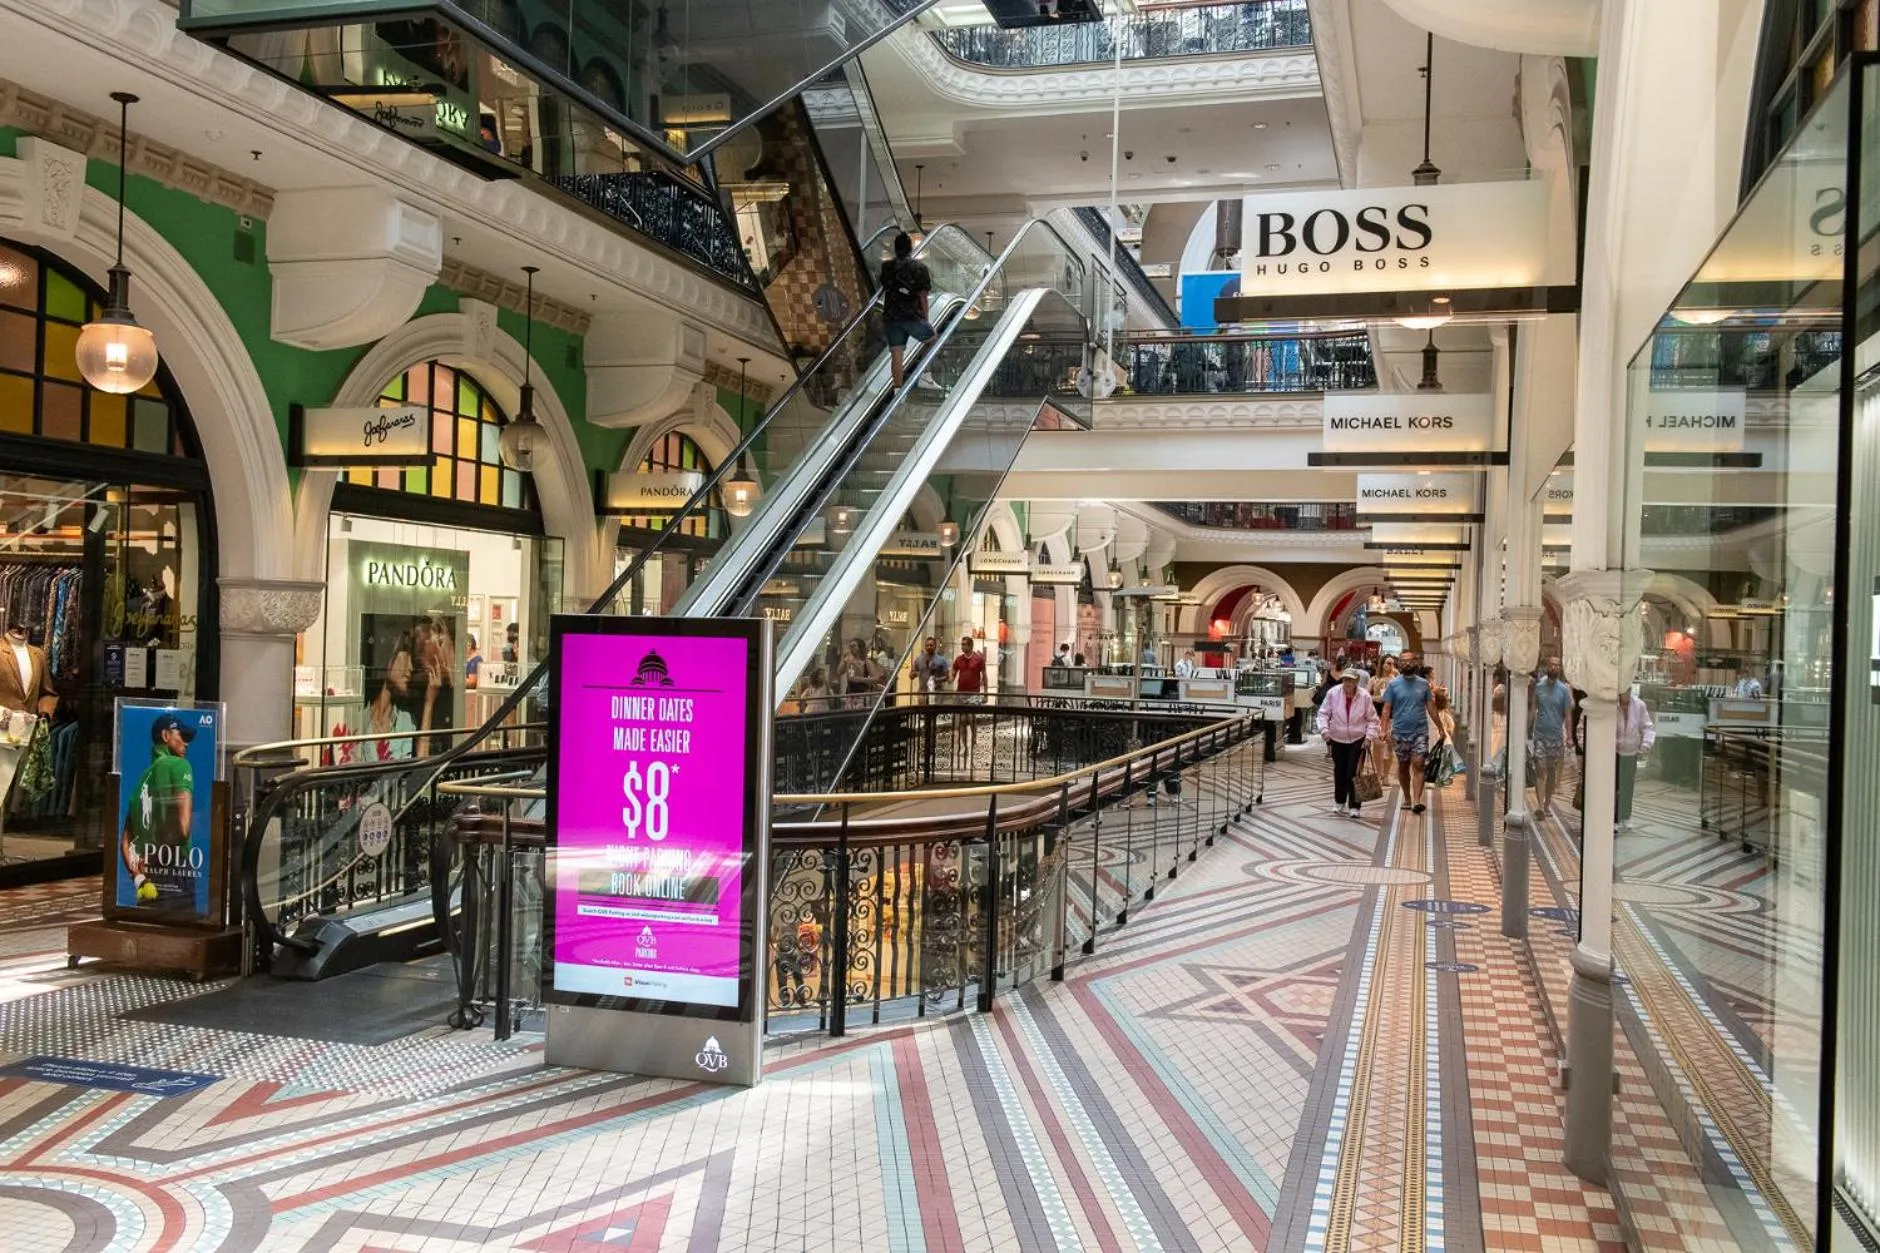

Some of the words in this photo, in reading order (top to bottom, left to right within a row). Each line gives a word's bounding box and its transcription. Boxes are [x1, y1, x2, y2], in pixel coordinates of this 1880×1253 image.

[1256, 204, 1432, 258] BOSS
[1256, 261, 1331, 276] HUGO
[1354, 256, 1430, 271] BOSS
[1330, 417, 1401, 429] MICHAEL
[1408, 416, 1453, 429] KORS
[1361, 489, 1411, 498] MICHAEL
[1415, 489, 1447, 498] KORS
[368, 559, 457, 589] PANDORA
[611, 695, 655, 721] DINNER
[658, 697, 694, 722] DATES
[613, 727, 647, 752] MADE
[650, 728, 691, 754] EASIER
[143, 843, 204, 870] POLO
[611, 872, 642, 896] BOOK
[645, 874, 685, 900] ONLINE
[695, 1051, 729, 1073] QVB
